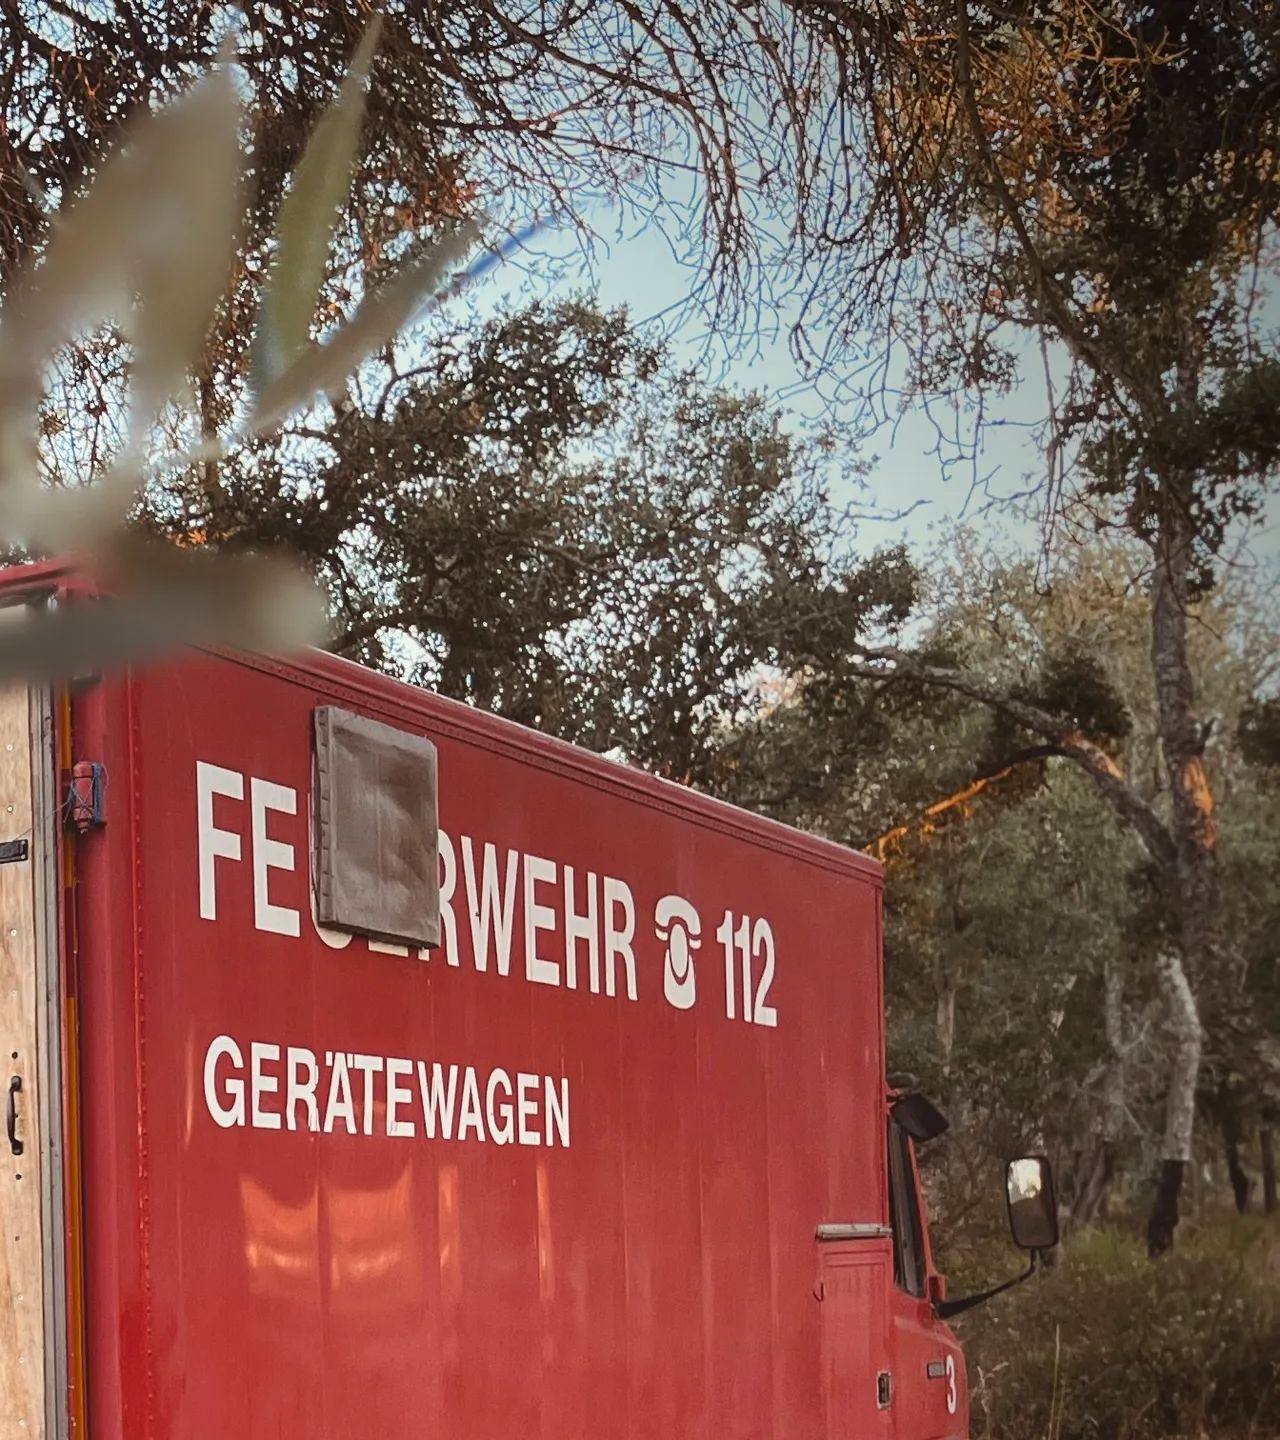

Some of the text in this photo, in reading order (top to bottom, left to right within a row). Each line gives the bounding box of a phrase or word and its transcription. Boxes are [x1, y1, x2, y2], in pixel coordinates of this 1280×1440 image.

[196, 760, 778, 1028] FERWEHR 112
[203, 1035, 571, 1148] GERÄTEWAGEN
[946, 1354, 957, 1414] 3
